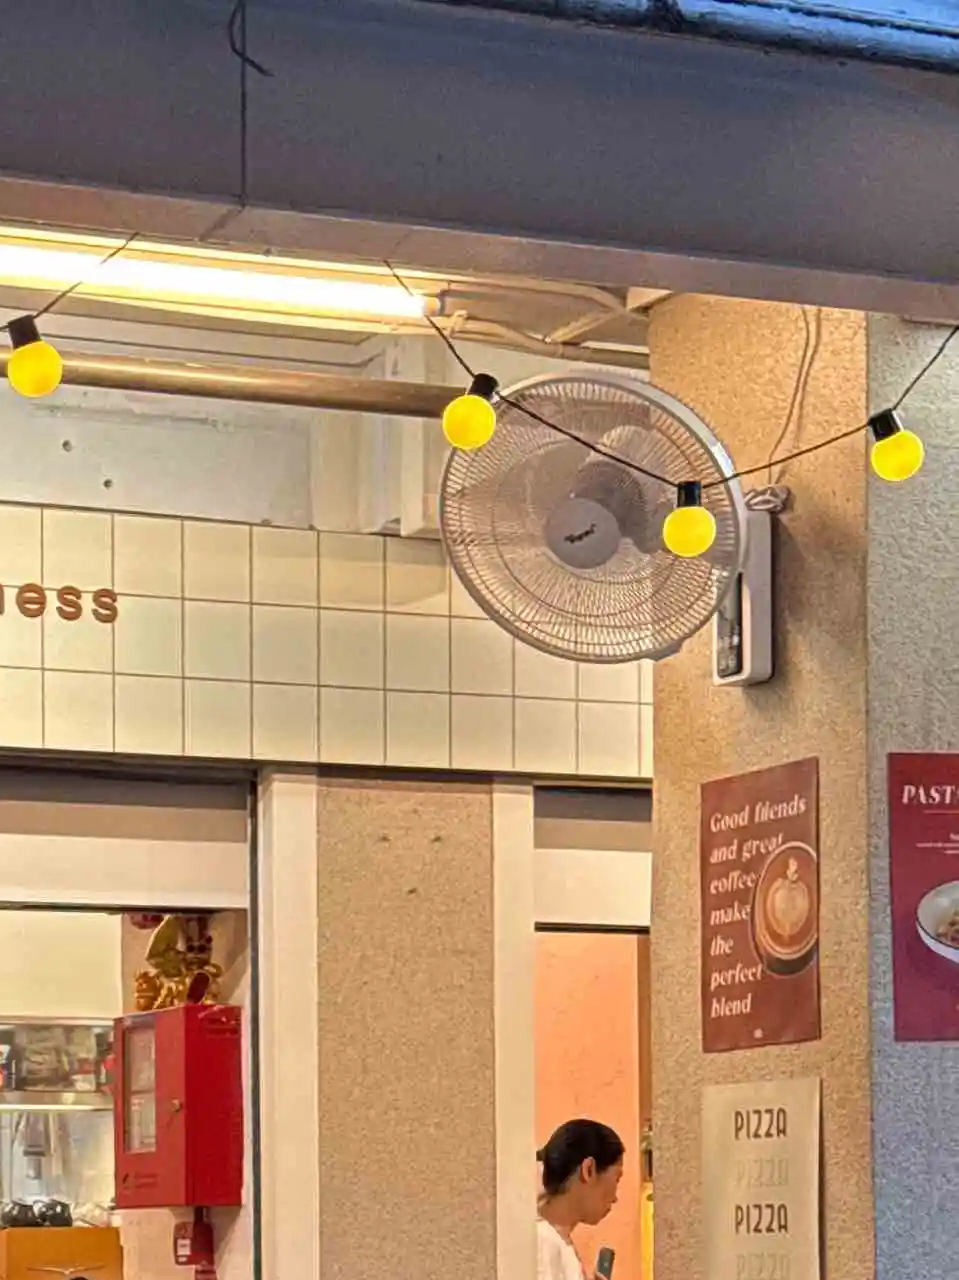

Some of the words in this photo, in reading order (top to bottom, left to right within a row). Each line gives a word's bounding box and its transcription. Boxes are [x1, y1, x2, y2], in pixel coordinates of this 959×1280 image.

[902, 784, 959, 804] PAST
[710, 805, 750, 833] Good
[754, 793, 807, 823] friends
[710, 838, 738, 863] and
[742, 832, 783, 862] great
[710, 870, 757, 894] coffee
[710, 900, 751, 925] make
[710, 935, 734, 956] the
[710, 962, 763, 992] perfect
[711, 993, 752, 1018] blend
[734, 1107, 787, 1140] PIZZA
[734, 1203, 788, 1235] PIZZA
